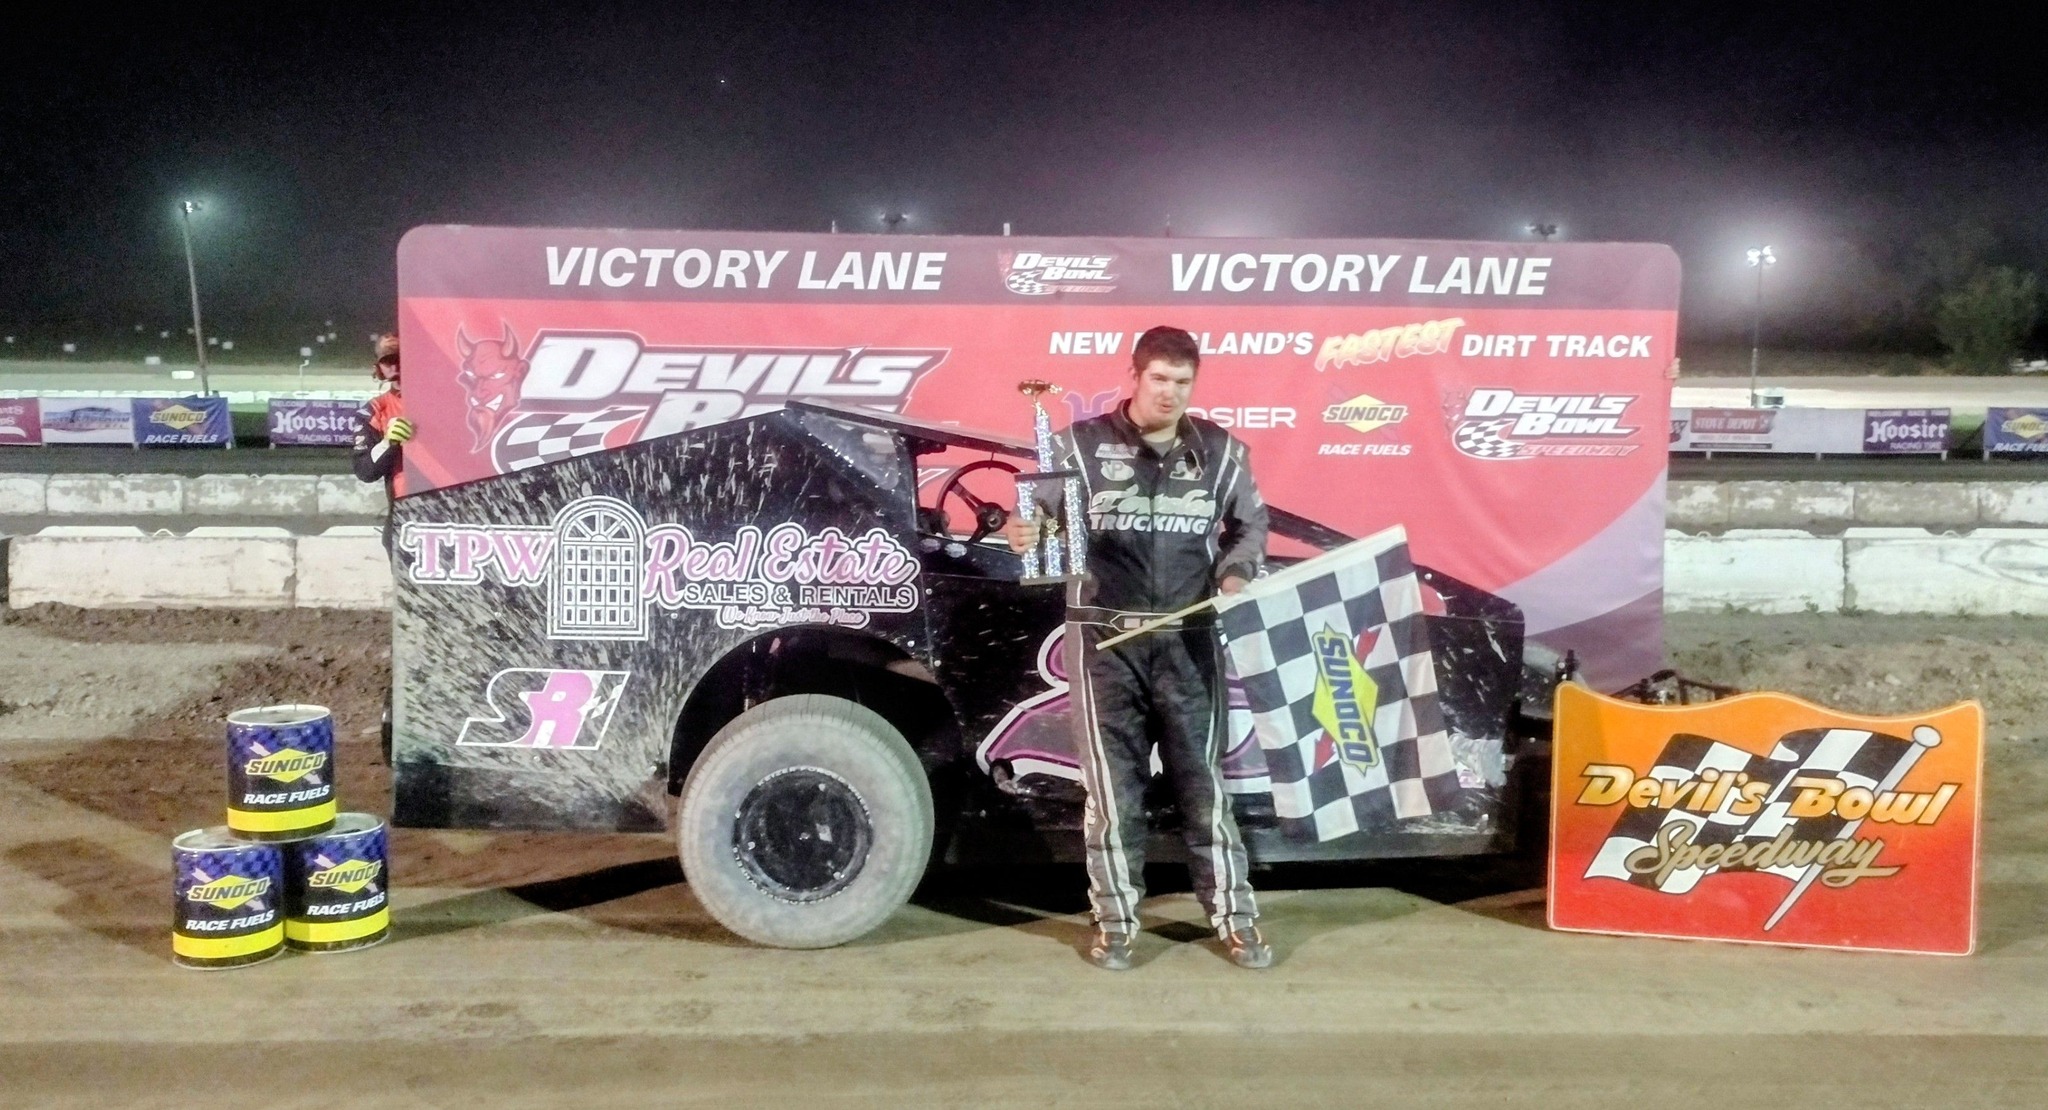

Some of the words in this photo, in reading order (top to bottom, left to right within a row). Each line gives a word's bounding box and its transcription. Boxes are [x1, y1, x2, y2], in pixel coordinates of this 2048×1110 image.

[545, 246, 789, 289] VICTORY
[797, 250, 947, 291] LANE
[1012, 253, 1112, 269] DEVIL'S
[1041, 267, 1113, 280] BOWL
[1170, 252, 1400, 293] VICTORY
[1408, 256, 1552, 297] LANE
[1049, 331, 1124, 355] NEW
[1314, 317, 1466, 373] FASTEST
[1461, 335, 1536, 358] DIRT
[1546, 335, 1651, 359] TRACK
[522, 336, 934, 400] DEVIL'S
[1325, 406, 1405, 421] SUNOCO
[1464, 389, 1634, 416] DEVIL'S
[152, 412, 205, 422] SUNOCO
[271, 410, 357, 433] Hoosier
[1184, 406, 1296, 428] OSIER
[1511, 412, 1635, 435] BOWL
[145, 434, 178, 443] RACE
[180, 434, 218, 443] FUELS
[297, 434, 331, 442] RACING
[333, 434, 354, 442] TIRE
[1865, 418, 1948, 443] Hoosier
[1318, 444, 1361, 455] RACE
[1362, 444, 1411, 455] FUELS
[1516, 445, 1640, 456] SPEEDWAY
[1089, 513, 1209, 535] TRUCKING
[404, 525, 557, 583] TPW
[641, 526, 760, 604] Real
[764, 525, 916, 586] Estate
[684, 582, 767, 605] SALES
[775, 584, 793, 605] &
[800, 585, 913, 608] RENTALS
[722, 606, 744, 624] We
[828, 606, 864, 625] Place
[1317, 636, 1374, 763] SUNOCO
[248, 751, 325, 774] SUNOCO
[243, 793, 286, 805] RACE
[288, 784, 330, 803] FUELS
[1577, 763, 1773, 816] Devil's
[1783, 777, 1961, 825] Bowl
[1624, 818, 1907, 888] Speedway
[311, 861, 381, 886] SUNOCO
[190, 878, 270, 901] SUNOCO
[307, 902, 349, 916] RACE
[351, 891, 385, 913] FUELS
[186, 918, 227, 931] RACE
[229, 909, 274, 930] FUELS
